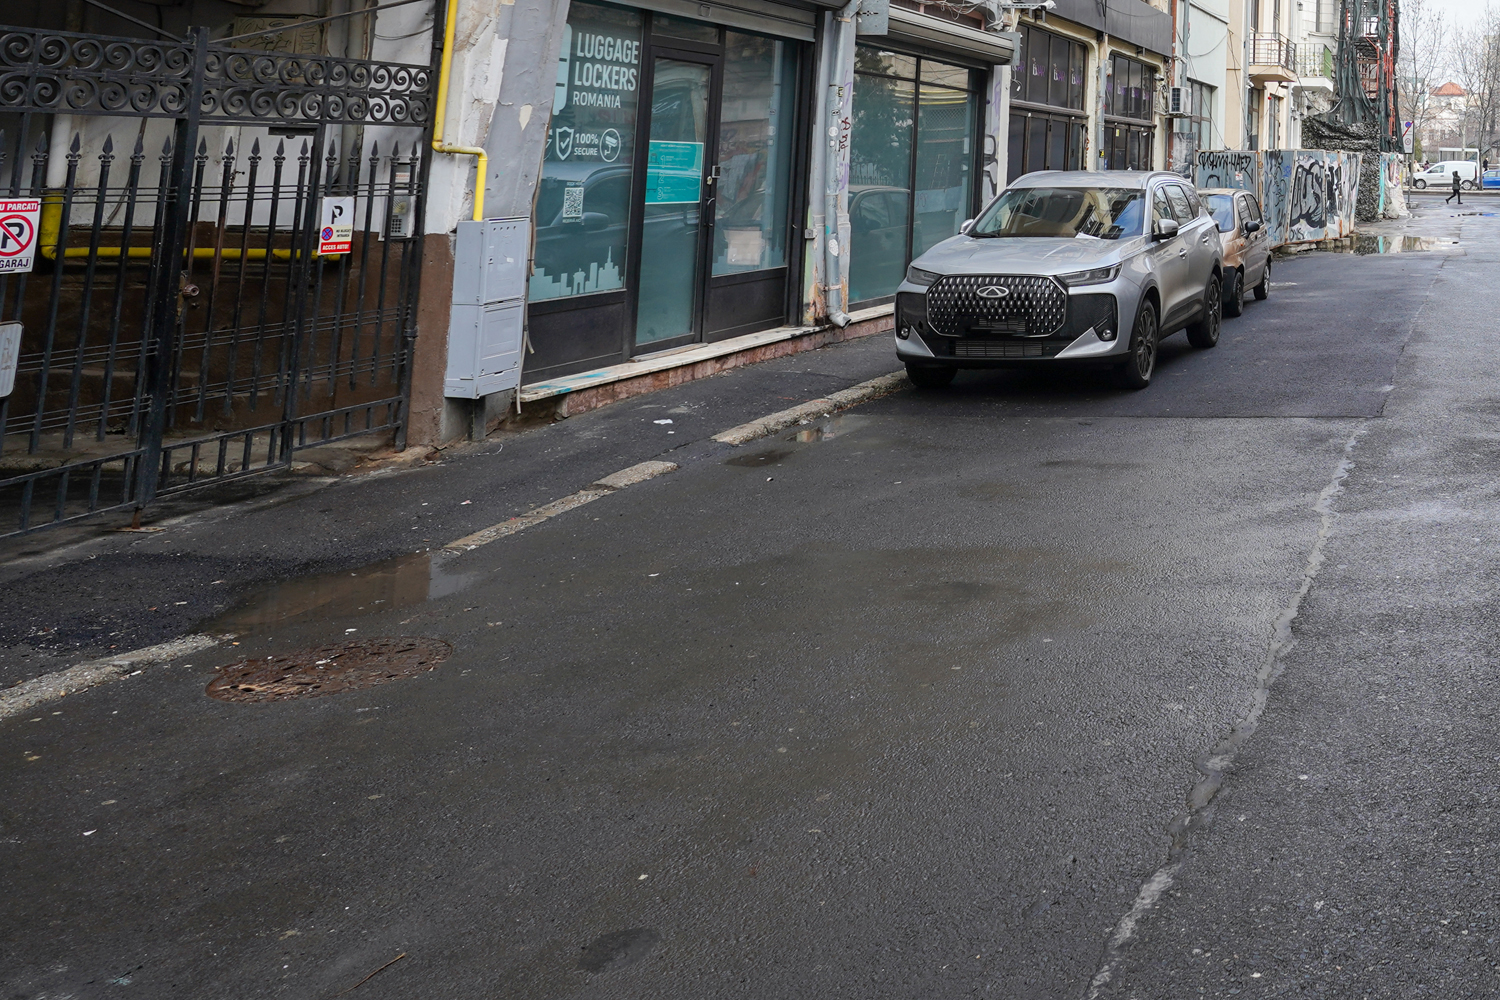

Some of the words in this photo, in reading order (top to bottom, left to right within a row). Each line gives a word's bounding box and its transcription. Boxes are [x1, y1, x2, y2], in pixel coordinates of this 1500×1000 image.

[577, 32, 640, 65] LUGGAGE
[574, 61, 637, 92] LOCKERS
[572, 91, 621, 109] ROMANIA
[575, 133, 599, 145] 100%
[574, 147, 598, 156] SECURE
[7, 202, 38, 211] PARCATI
